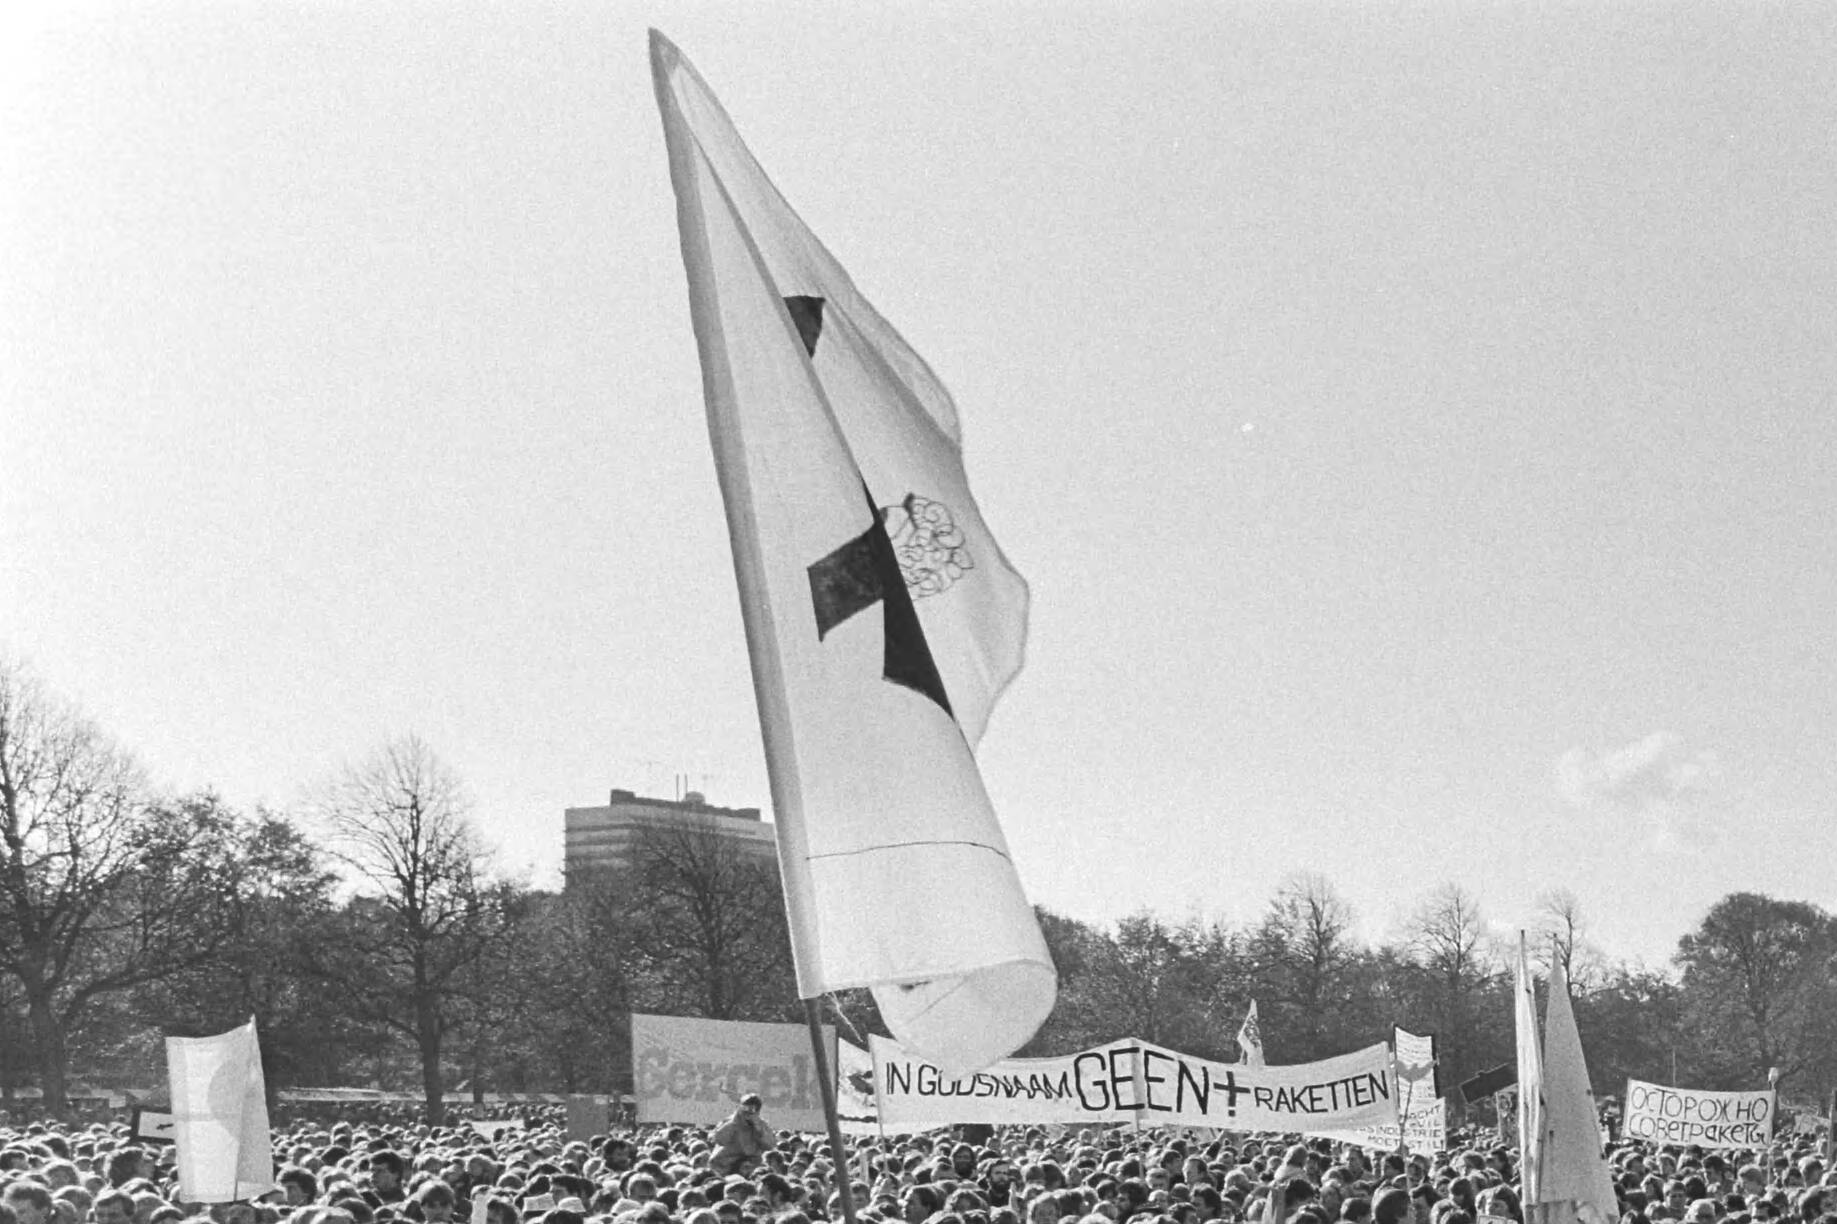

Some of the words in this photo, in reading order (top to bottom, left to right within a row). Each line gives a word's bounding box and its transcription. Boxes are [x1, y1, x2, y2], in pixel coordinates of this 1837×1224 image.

[886, 1062, 911, 1095] IN
[1074, 1047, 1210, 1115] GEEN
[1254, 1070, 1389, 1113] RAKETTEN
